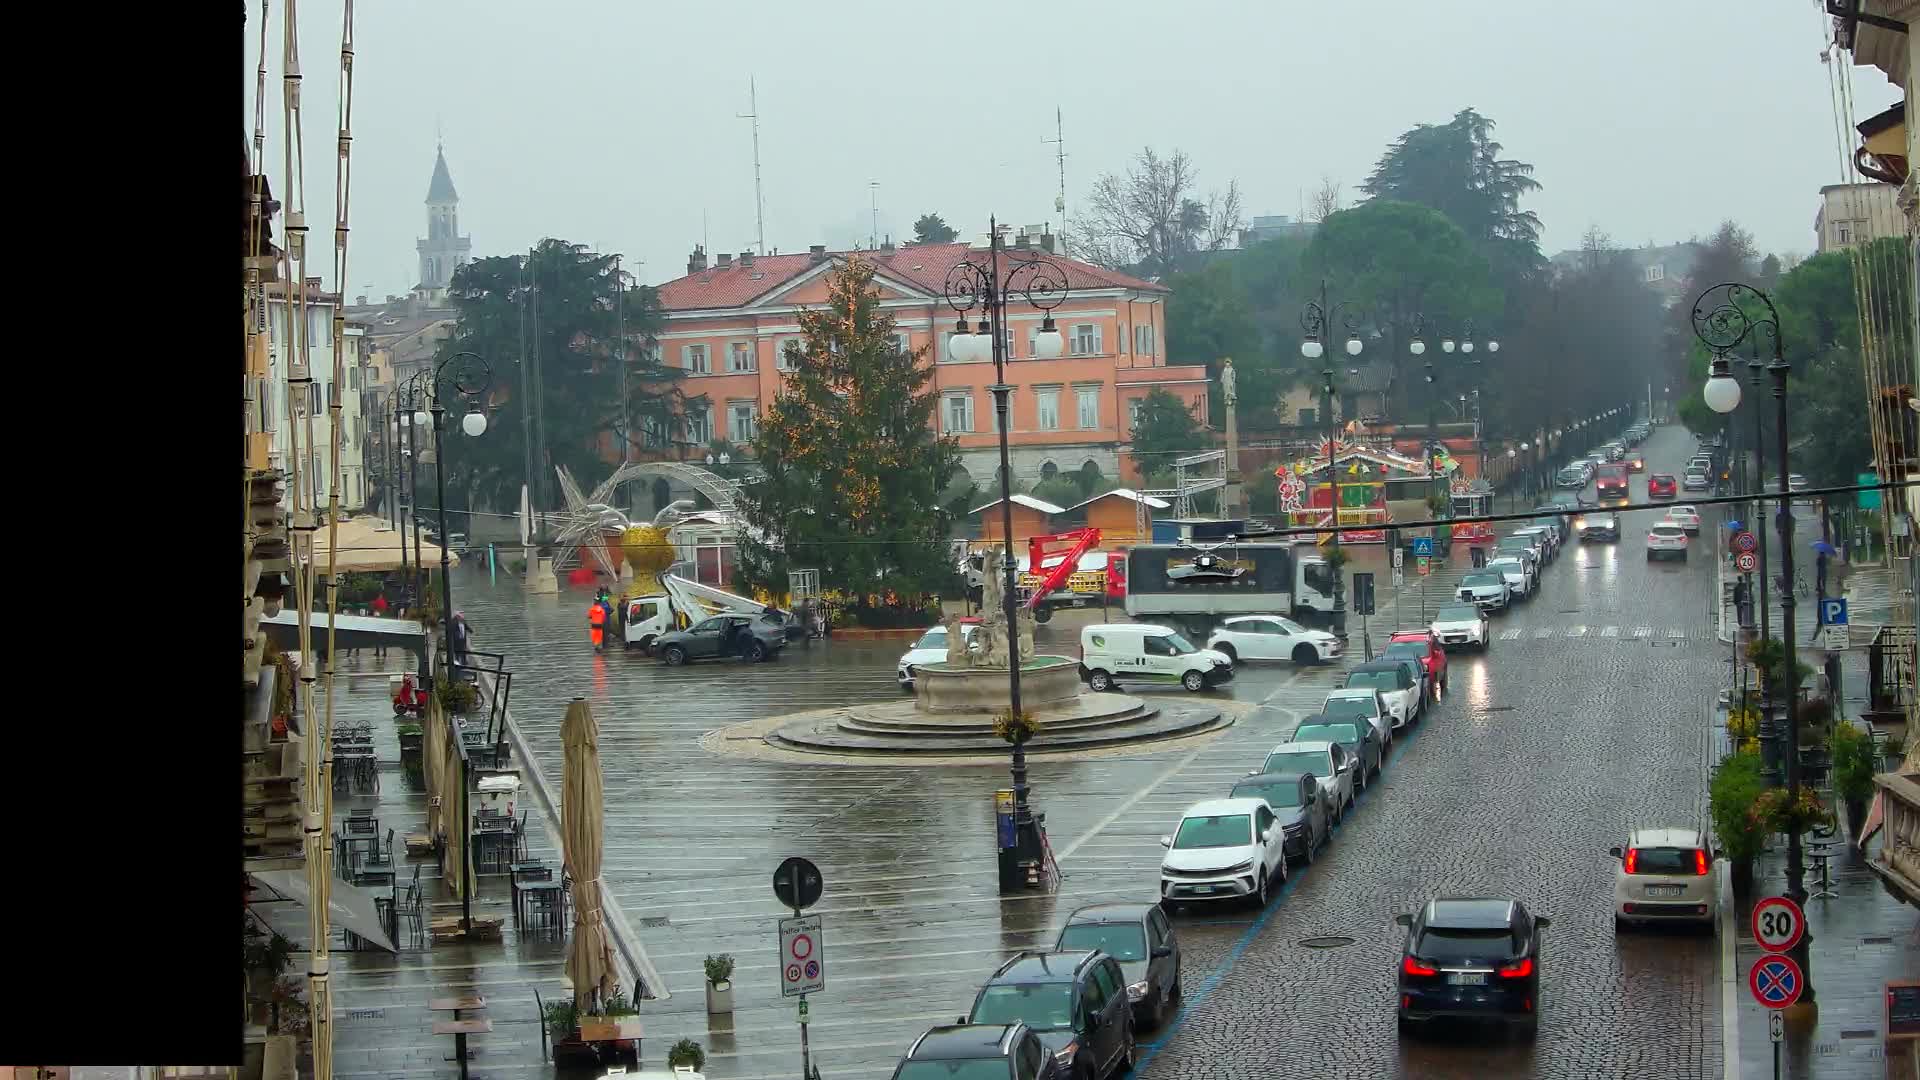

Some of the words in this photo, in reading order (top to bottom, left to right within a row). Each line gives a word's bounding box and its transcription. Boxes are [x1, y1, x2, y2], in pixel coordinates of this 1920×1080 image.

[1742, 557, 1752, 566] 20
[1827, 602, 1842, 621] P
[1762, 911, 1791, 937] 30
